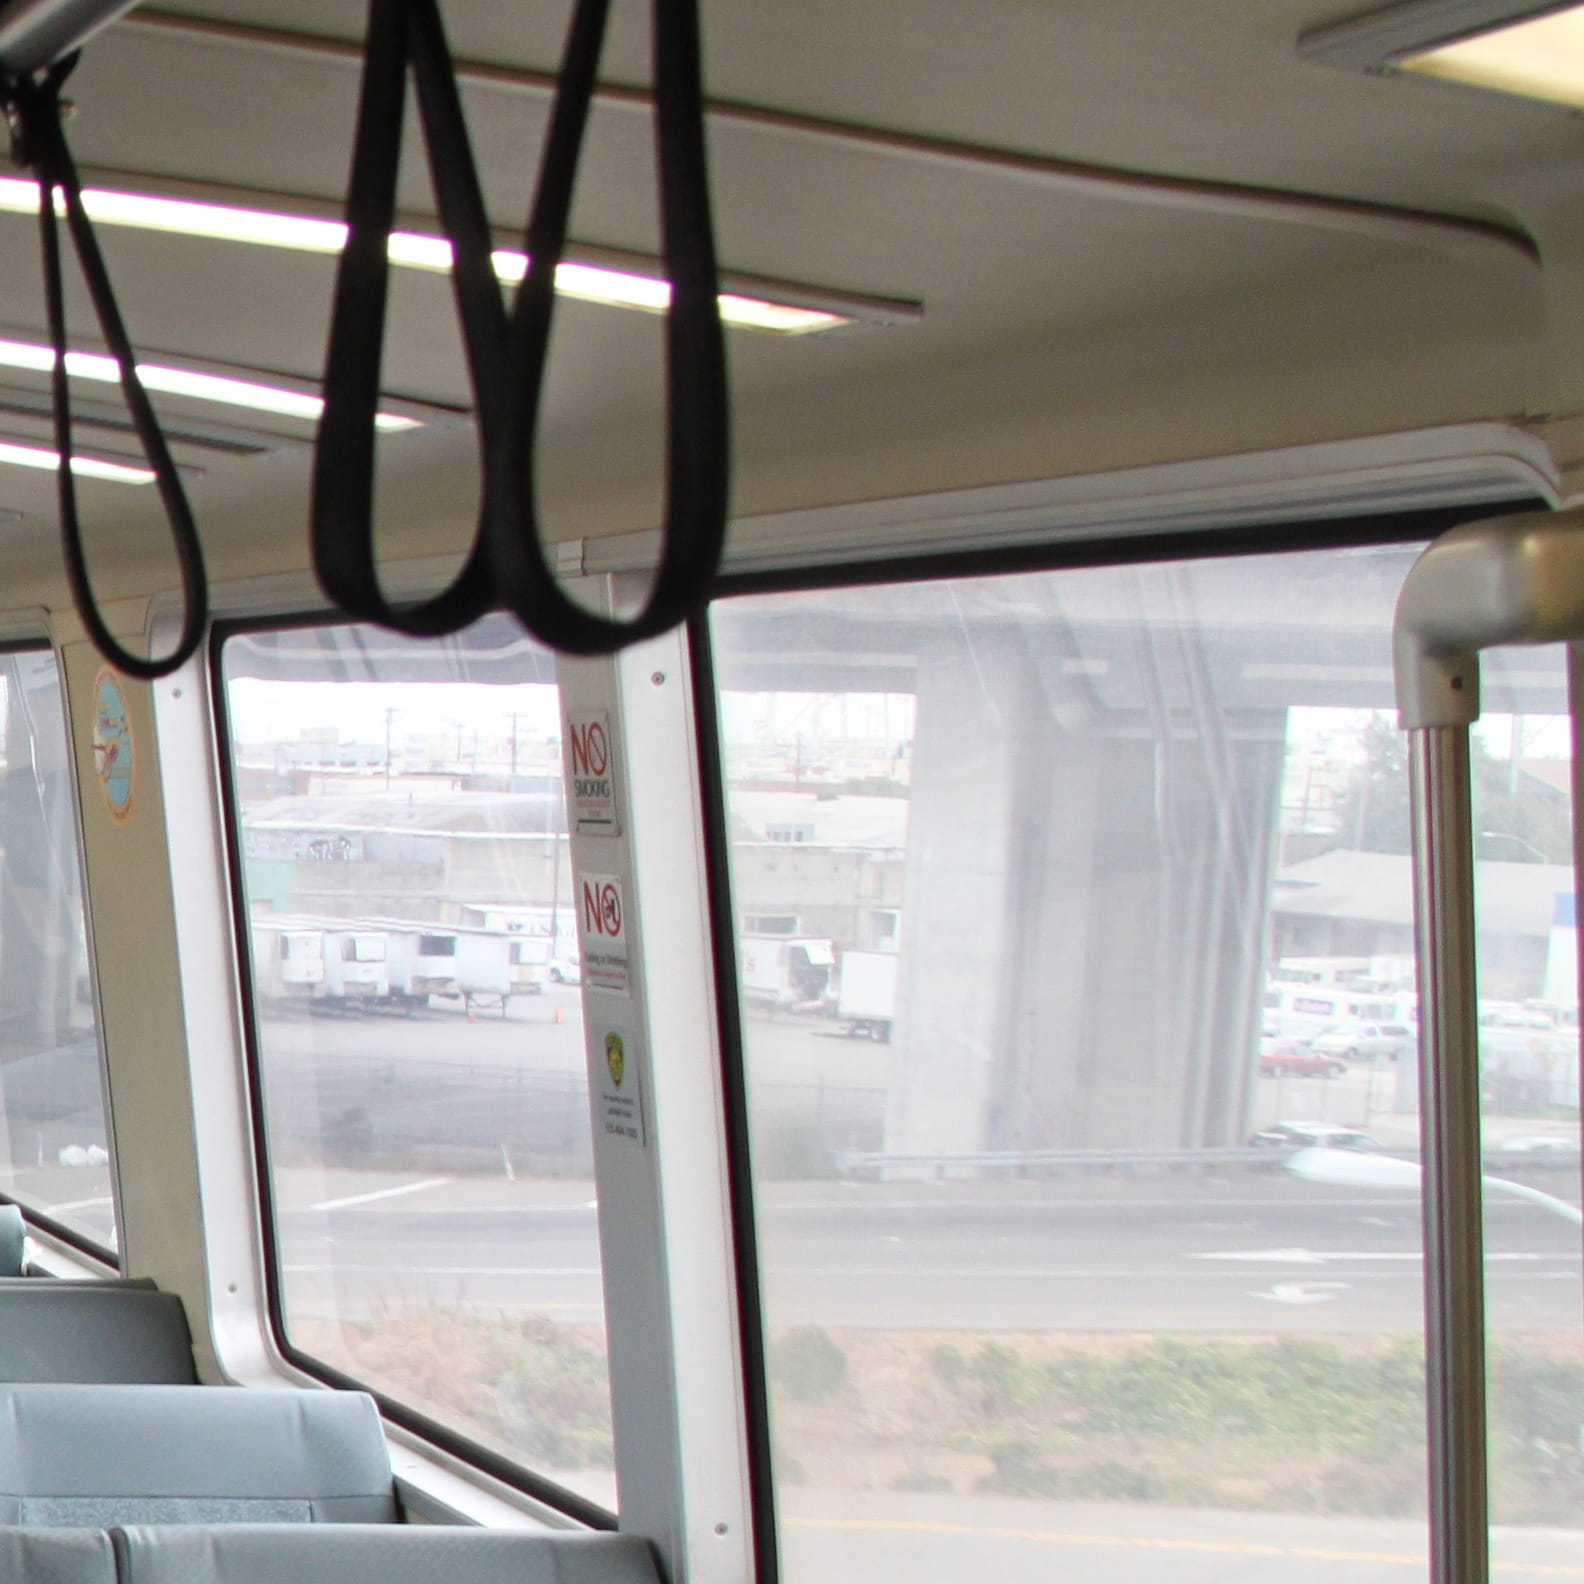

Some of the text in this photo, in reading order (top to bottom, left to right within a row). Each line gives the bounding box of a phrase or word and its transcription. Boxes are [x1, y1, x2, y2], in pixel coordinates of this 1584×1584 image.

[570, 722, 607, 776] NO
[574, 780, 609, 797] SMOKING
[583, 881, 621, 936] NO
